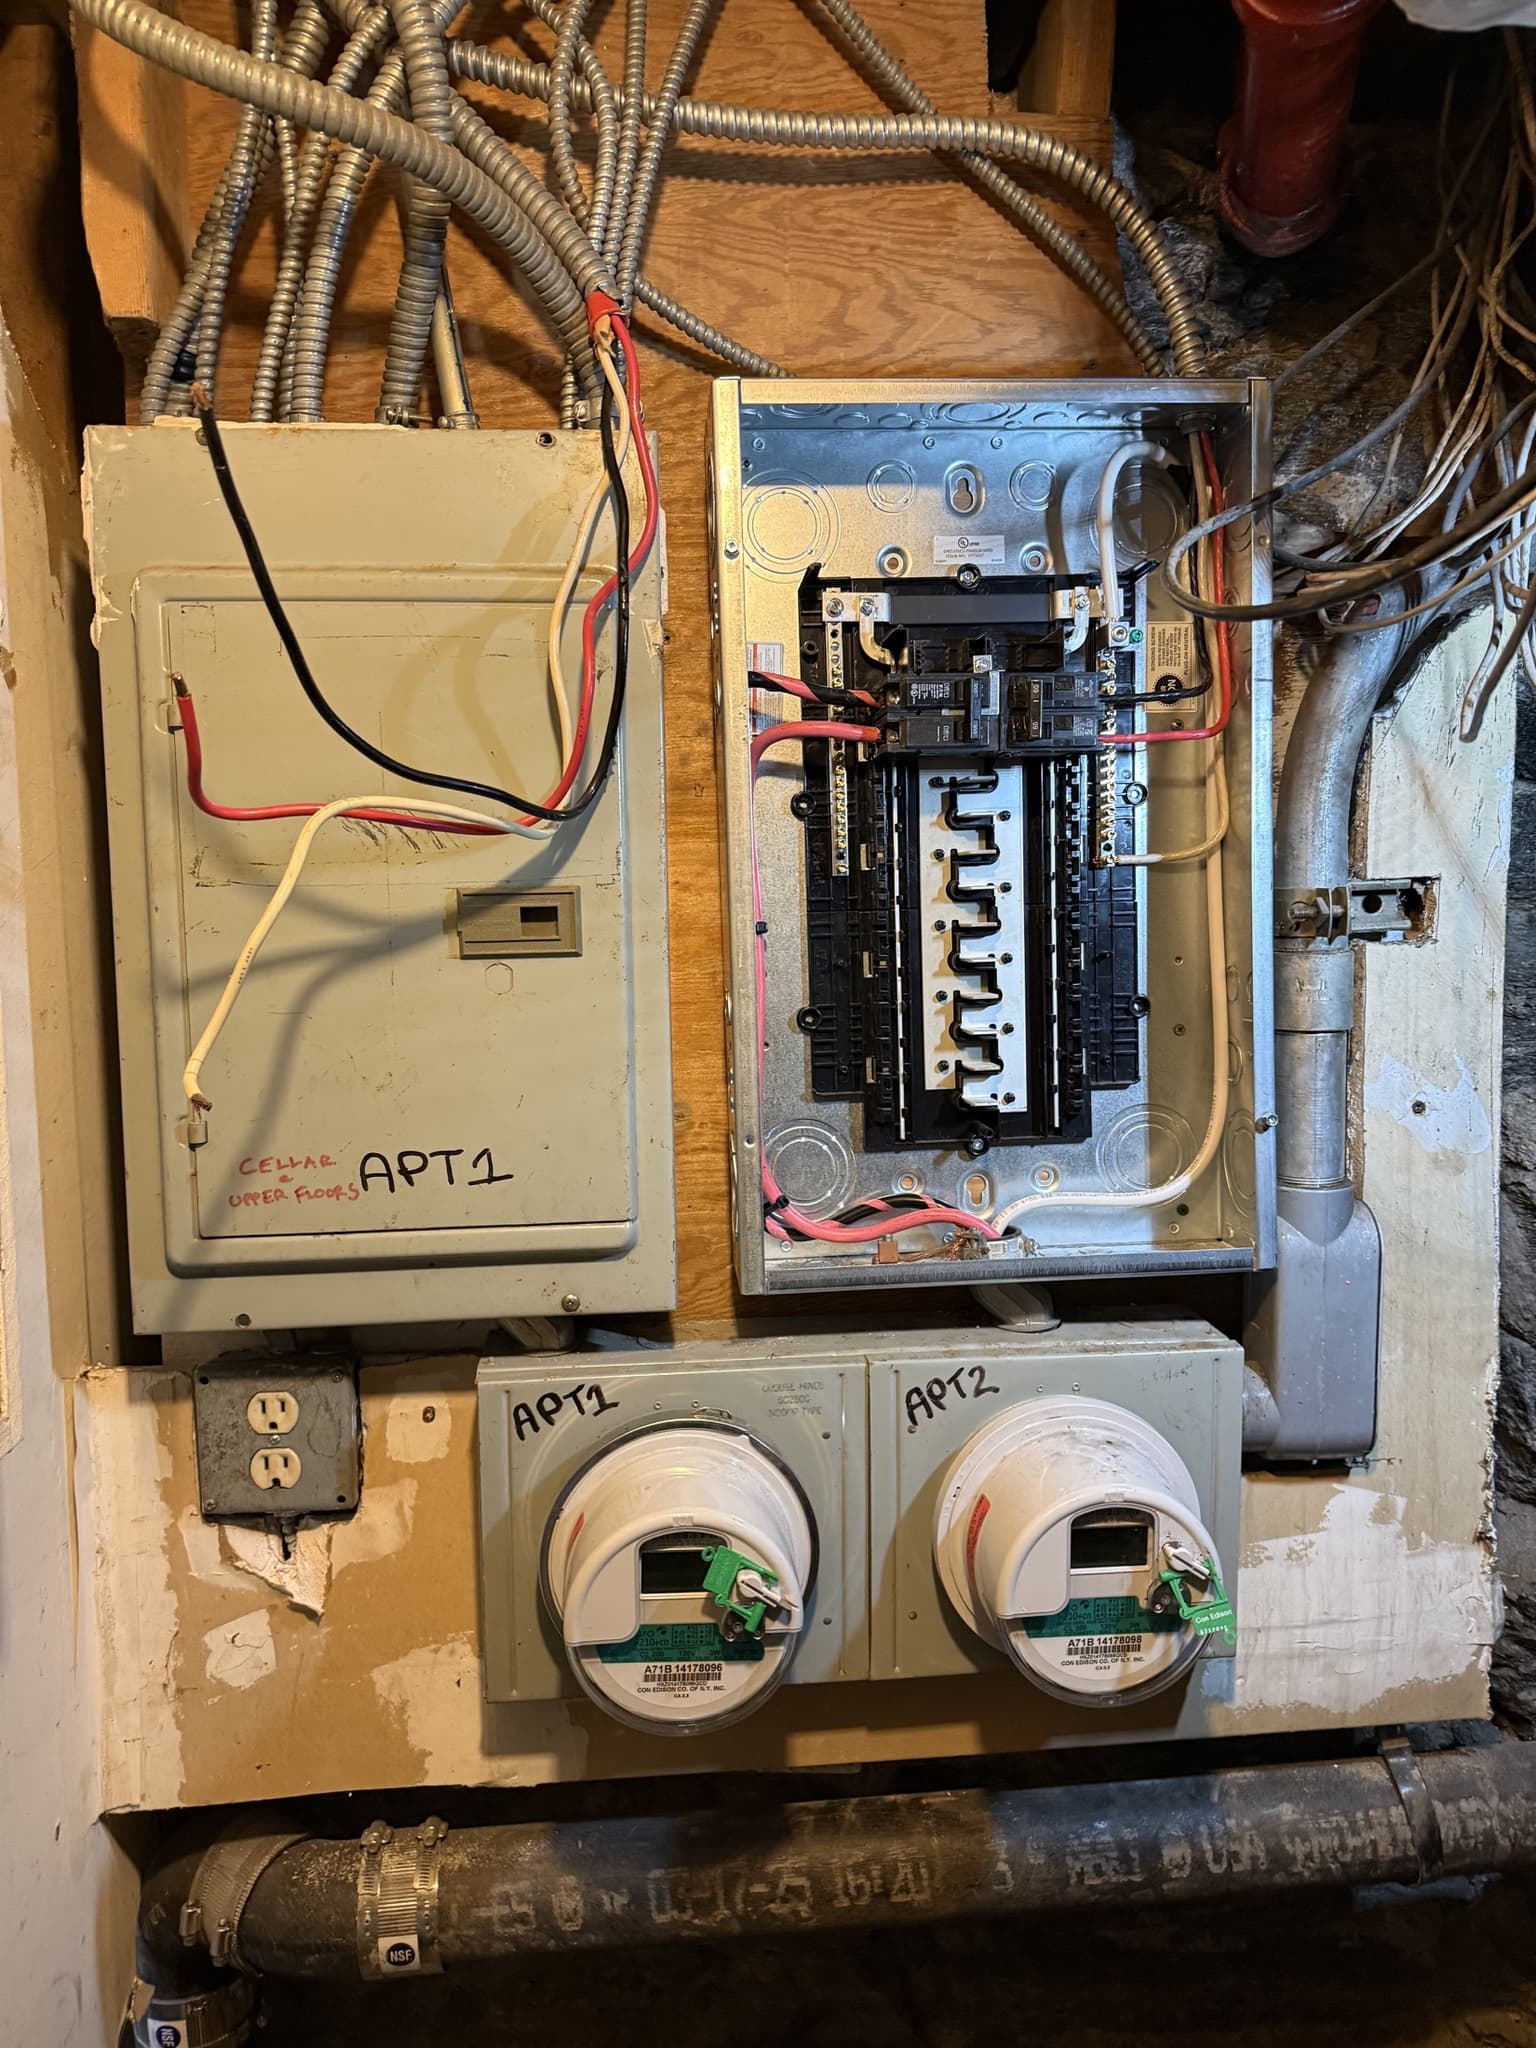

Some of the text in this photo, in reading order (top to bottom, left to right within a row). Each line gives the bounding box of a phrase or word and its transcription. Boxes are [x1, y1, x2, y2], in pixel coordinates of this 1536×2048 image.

[239, 1154, 337, 1176] CELLAR
[228, 1182, 361, 1208] UPPER FLOORS
[904, 1365, 1001, 1426] APT2
[511, 1383, 620, 1441] APT1
[1196, 1609, 1232, 1624] Con Edison
[1068, 1635, 1142, 1647] A71B 14178098
[644, 1664, 723, 1673] A71B 14178096
[390, 1950, 412, 1962] NSF
[160, 2028, 174, 2047] NSF
